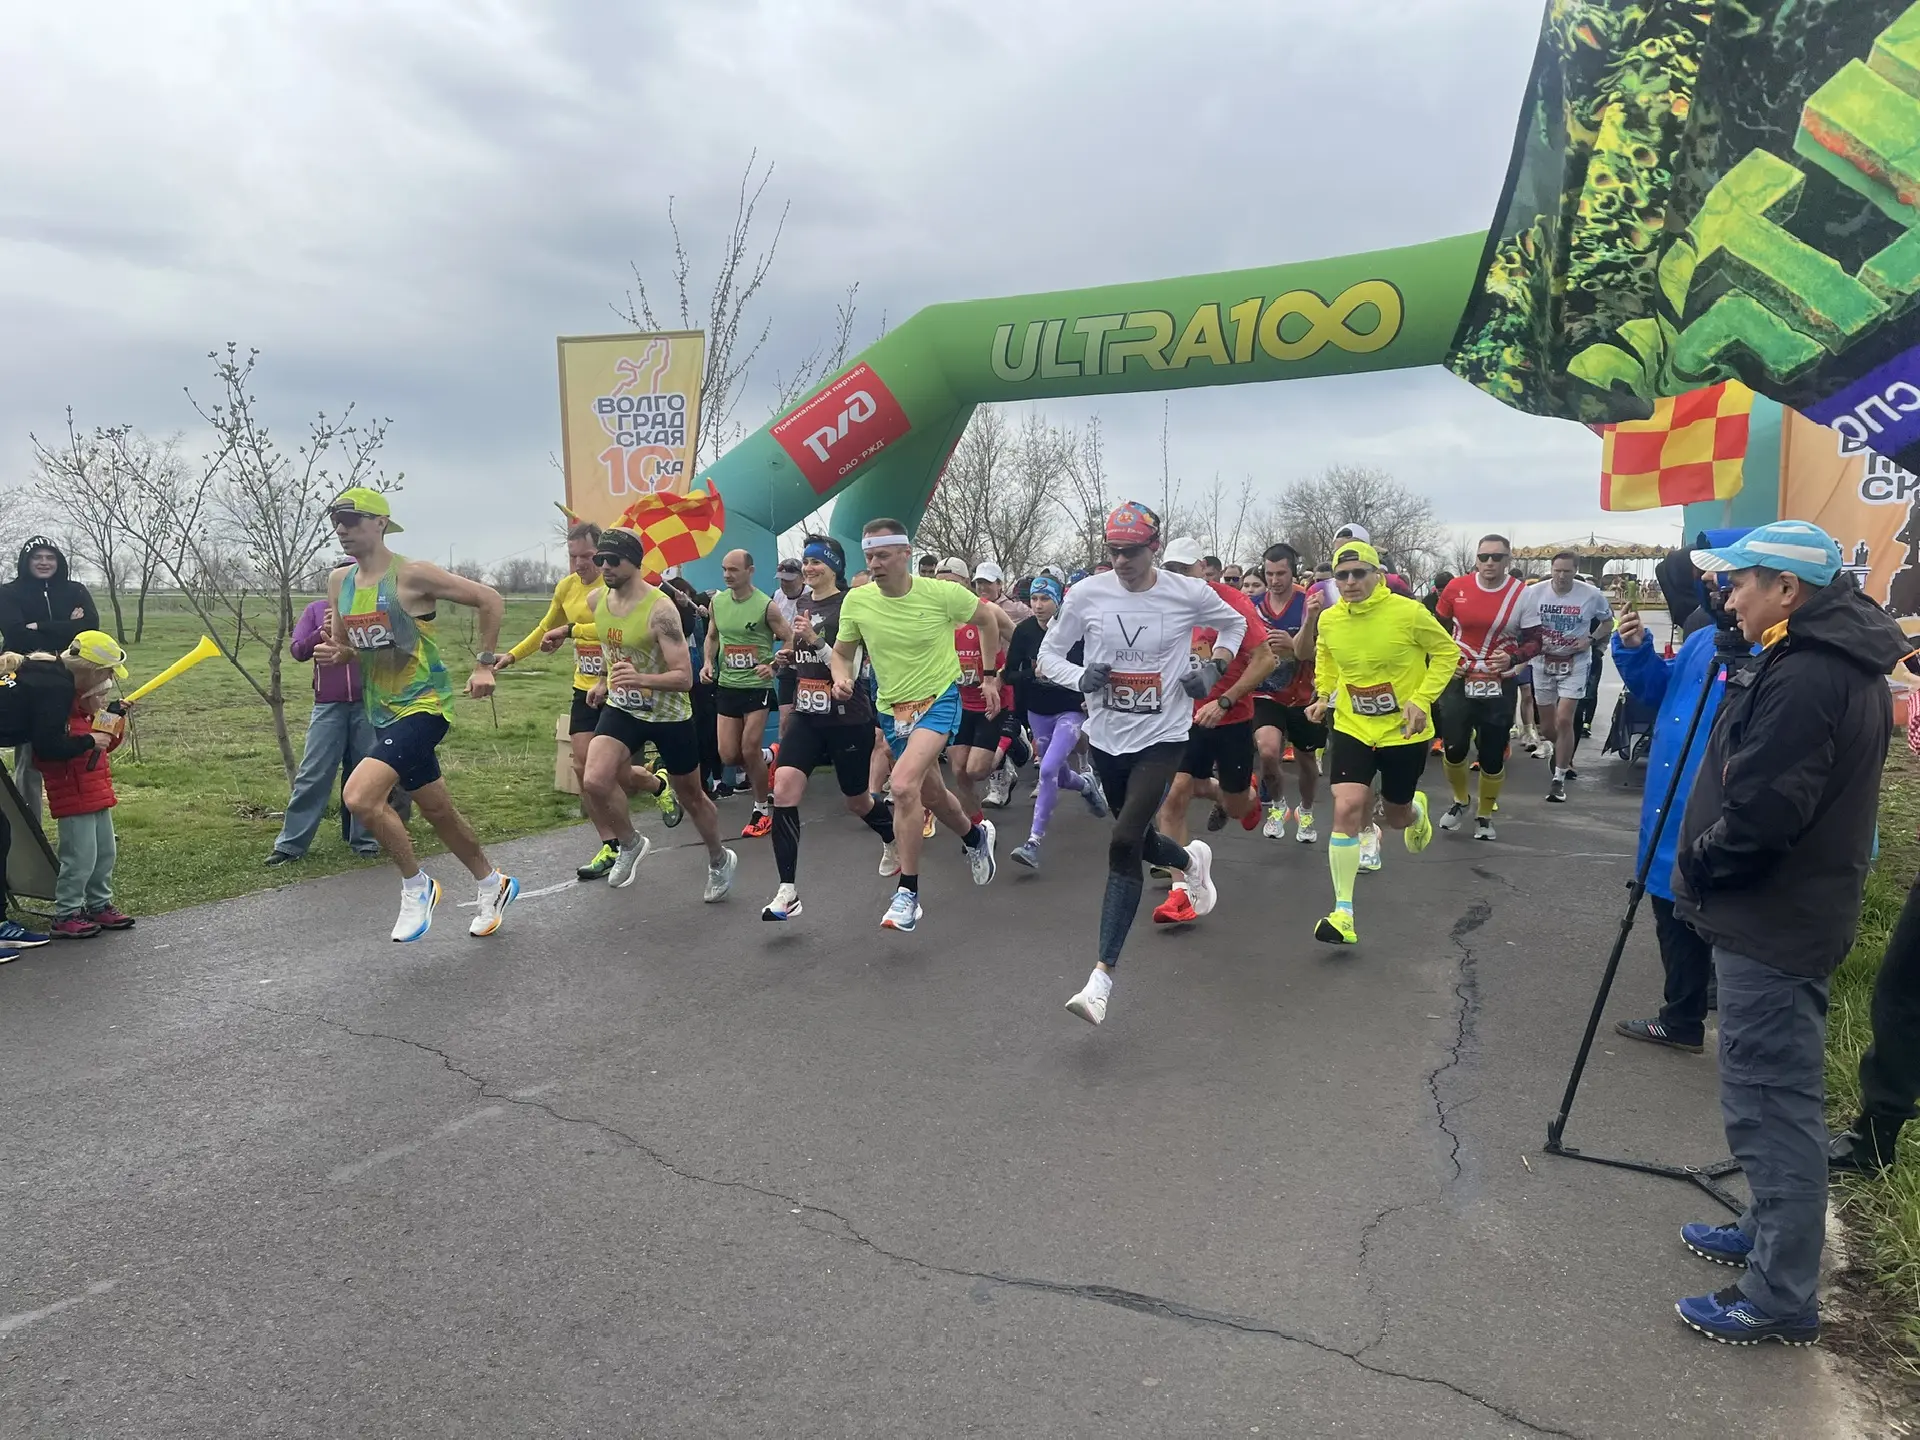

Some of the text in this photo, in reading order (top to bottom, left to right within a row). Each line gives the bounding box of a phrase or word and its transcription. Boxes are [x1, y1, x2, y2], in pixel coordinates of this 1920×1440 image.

[597, 394, 685, 415] ВОЛГО
[617, 412, 684, 431] ГРАД
[615, 429, 684, 447] СКАЯ
[838, 458, 858, 475] ОАО
[348, 624, 390, 648] 112
[728, 653, 754, 668] 181
[1115, 650, 1144, 662] RUN
[1104, 684, 1160, 710] 134
[1466, 681, 1500, 697] 122
[1352, 693, 1396, 713] 159
